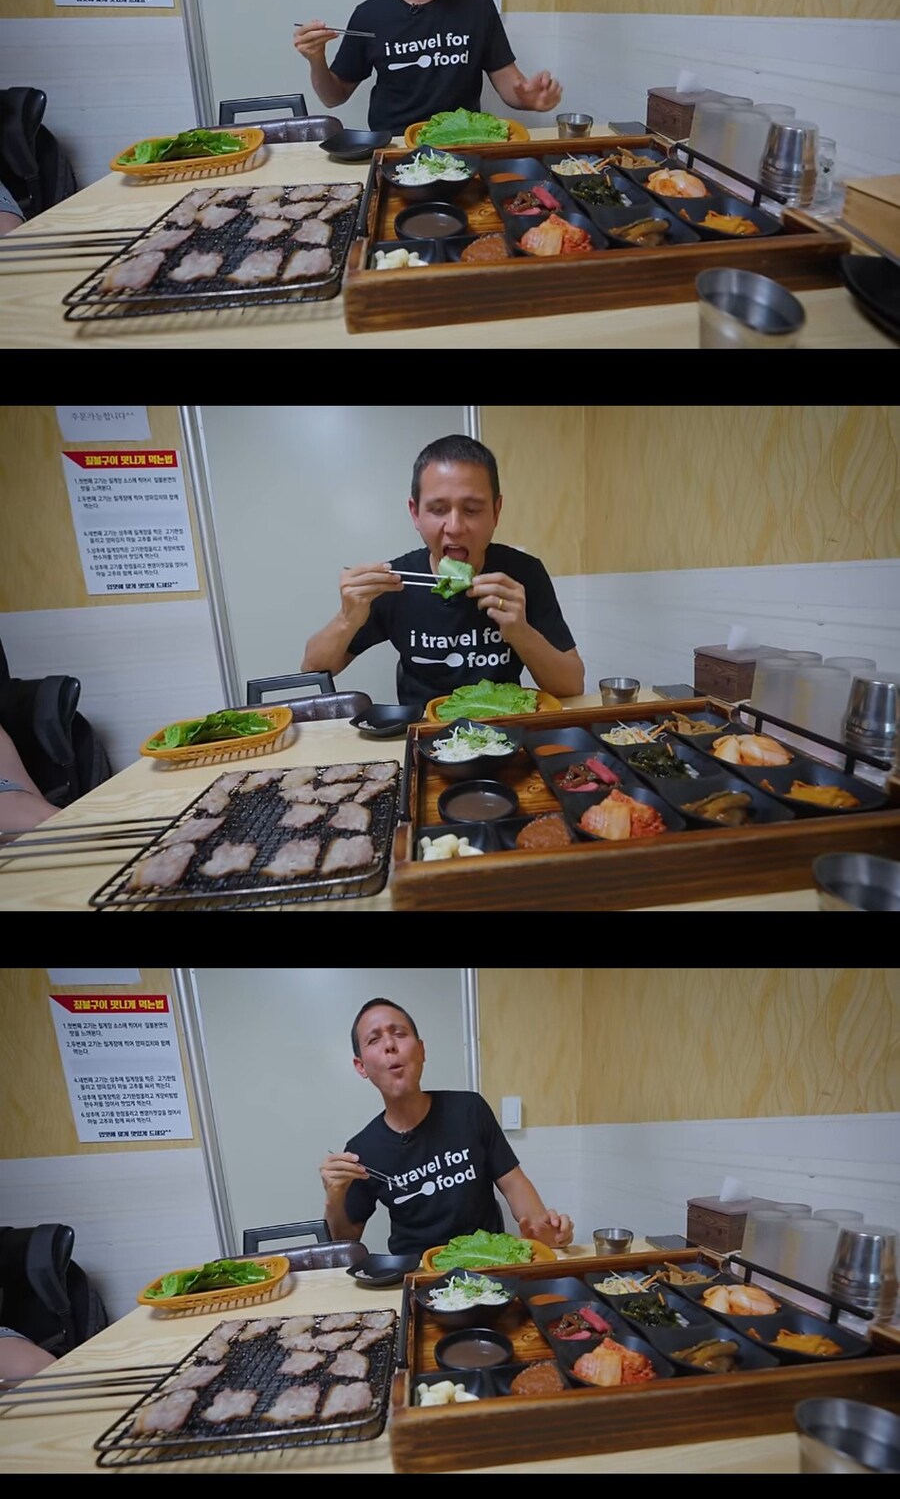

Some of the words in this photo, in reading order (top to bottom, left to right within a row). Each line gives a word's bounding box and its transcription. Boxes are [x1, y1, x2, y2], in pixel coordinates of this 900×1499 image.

[385, 42, 390, 56] i
[394, 33, 441, 55] travel
[445, 33, 469, 47] for
[433, 50, 469, 66] food
[411, 630, 416, 647] i
[421, 629, 477, 649] travel
[483, 627, 506, 644] fo
[467, 648, 511, 667] food
[394, 1155, 441, 1187] travel
[444, 1148, 469, 1167] for
[436, 1165, 476, 1190] food
